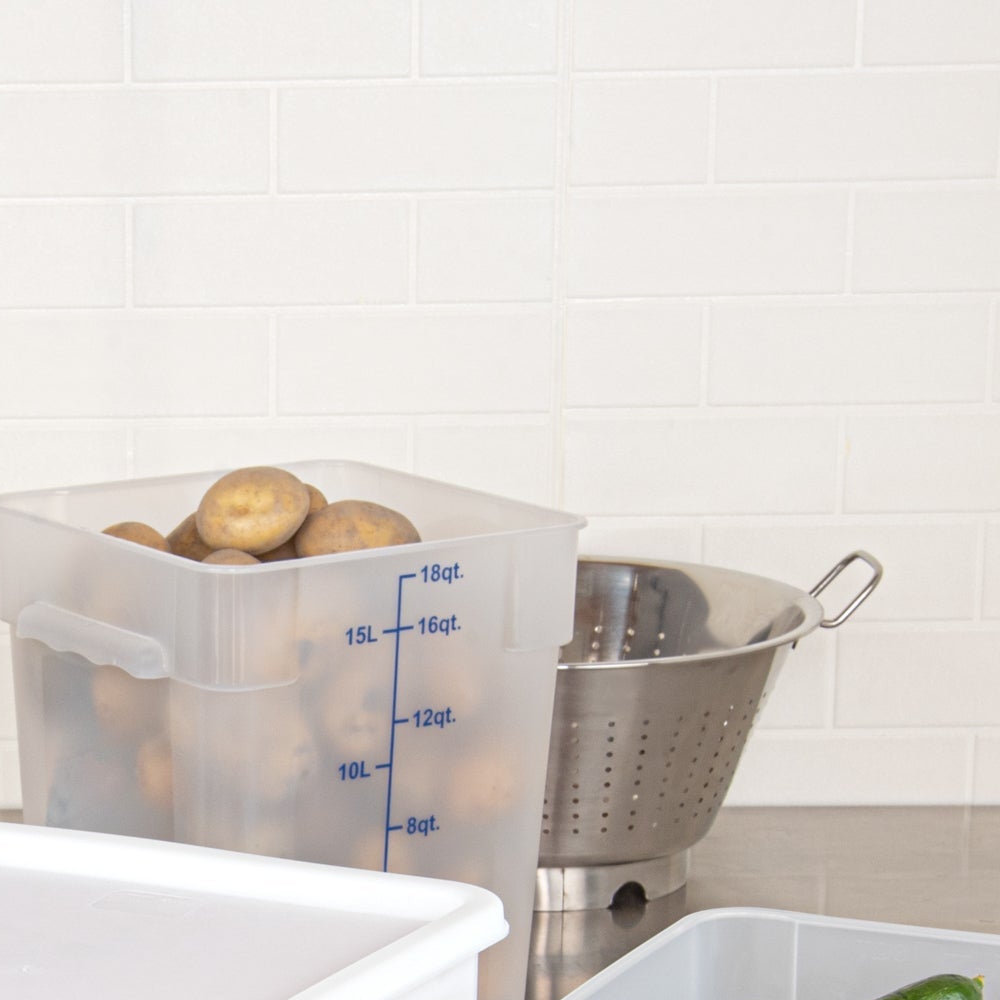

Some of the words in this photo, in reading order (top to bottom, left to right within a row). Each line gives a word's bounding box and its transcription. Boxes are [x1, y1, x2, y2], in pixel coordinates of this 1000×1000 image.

[421, 563, 464, 584] 18qt.
[345, 625, 377, 645] 15L
[418, 614, 461, 636] 16qt.
[412, 708, 456, 729] 12qt.
[338, 761, 371, 781] 10L
[406, 815, 440, 836] 8qt.
